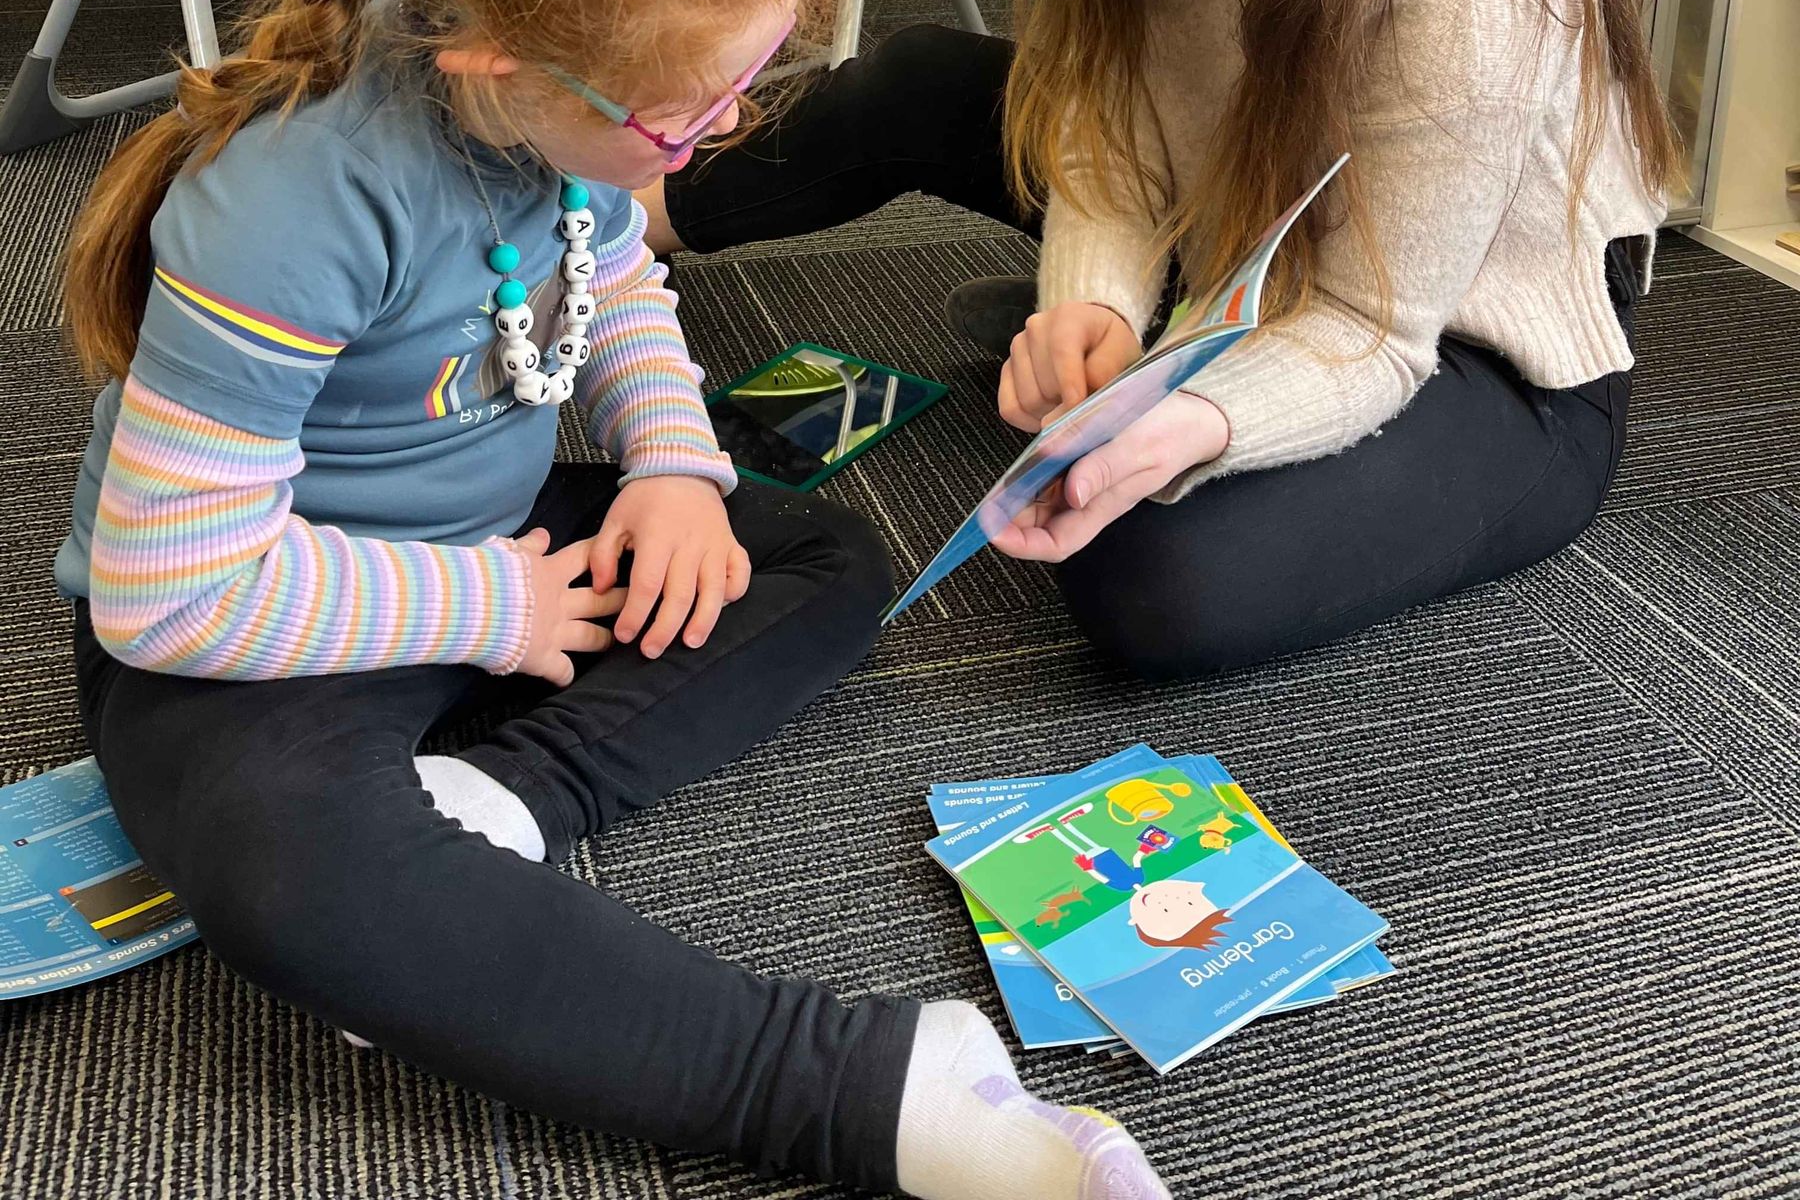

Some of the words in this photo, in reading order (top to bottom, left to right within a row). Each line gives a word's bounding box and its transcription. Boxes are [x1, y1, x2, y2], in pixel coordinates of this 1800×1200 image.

[944, 796, 984, 808] Sounds
[985, 794, 1005, 804] and
[998, 801, 1030, 820] Letters
[979, 815, 998, 831] and
[943, 825, 980, 847] Sounds
[159, 931, 170, 942] &
[107, 937, 159, 962] Sounds
[1180, 921, 1295, 988] Gardening
[38, 961, 93, 983] Fiction
[1267, 966, 1290, 982] Book
